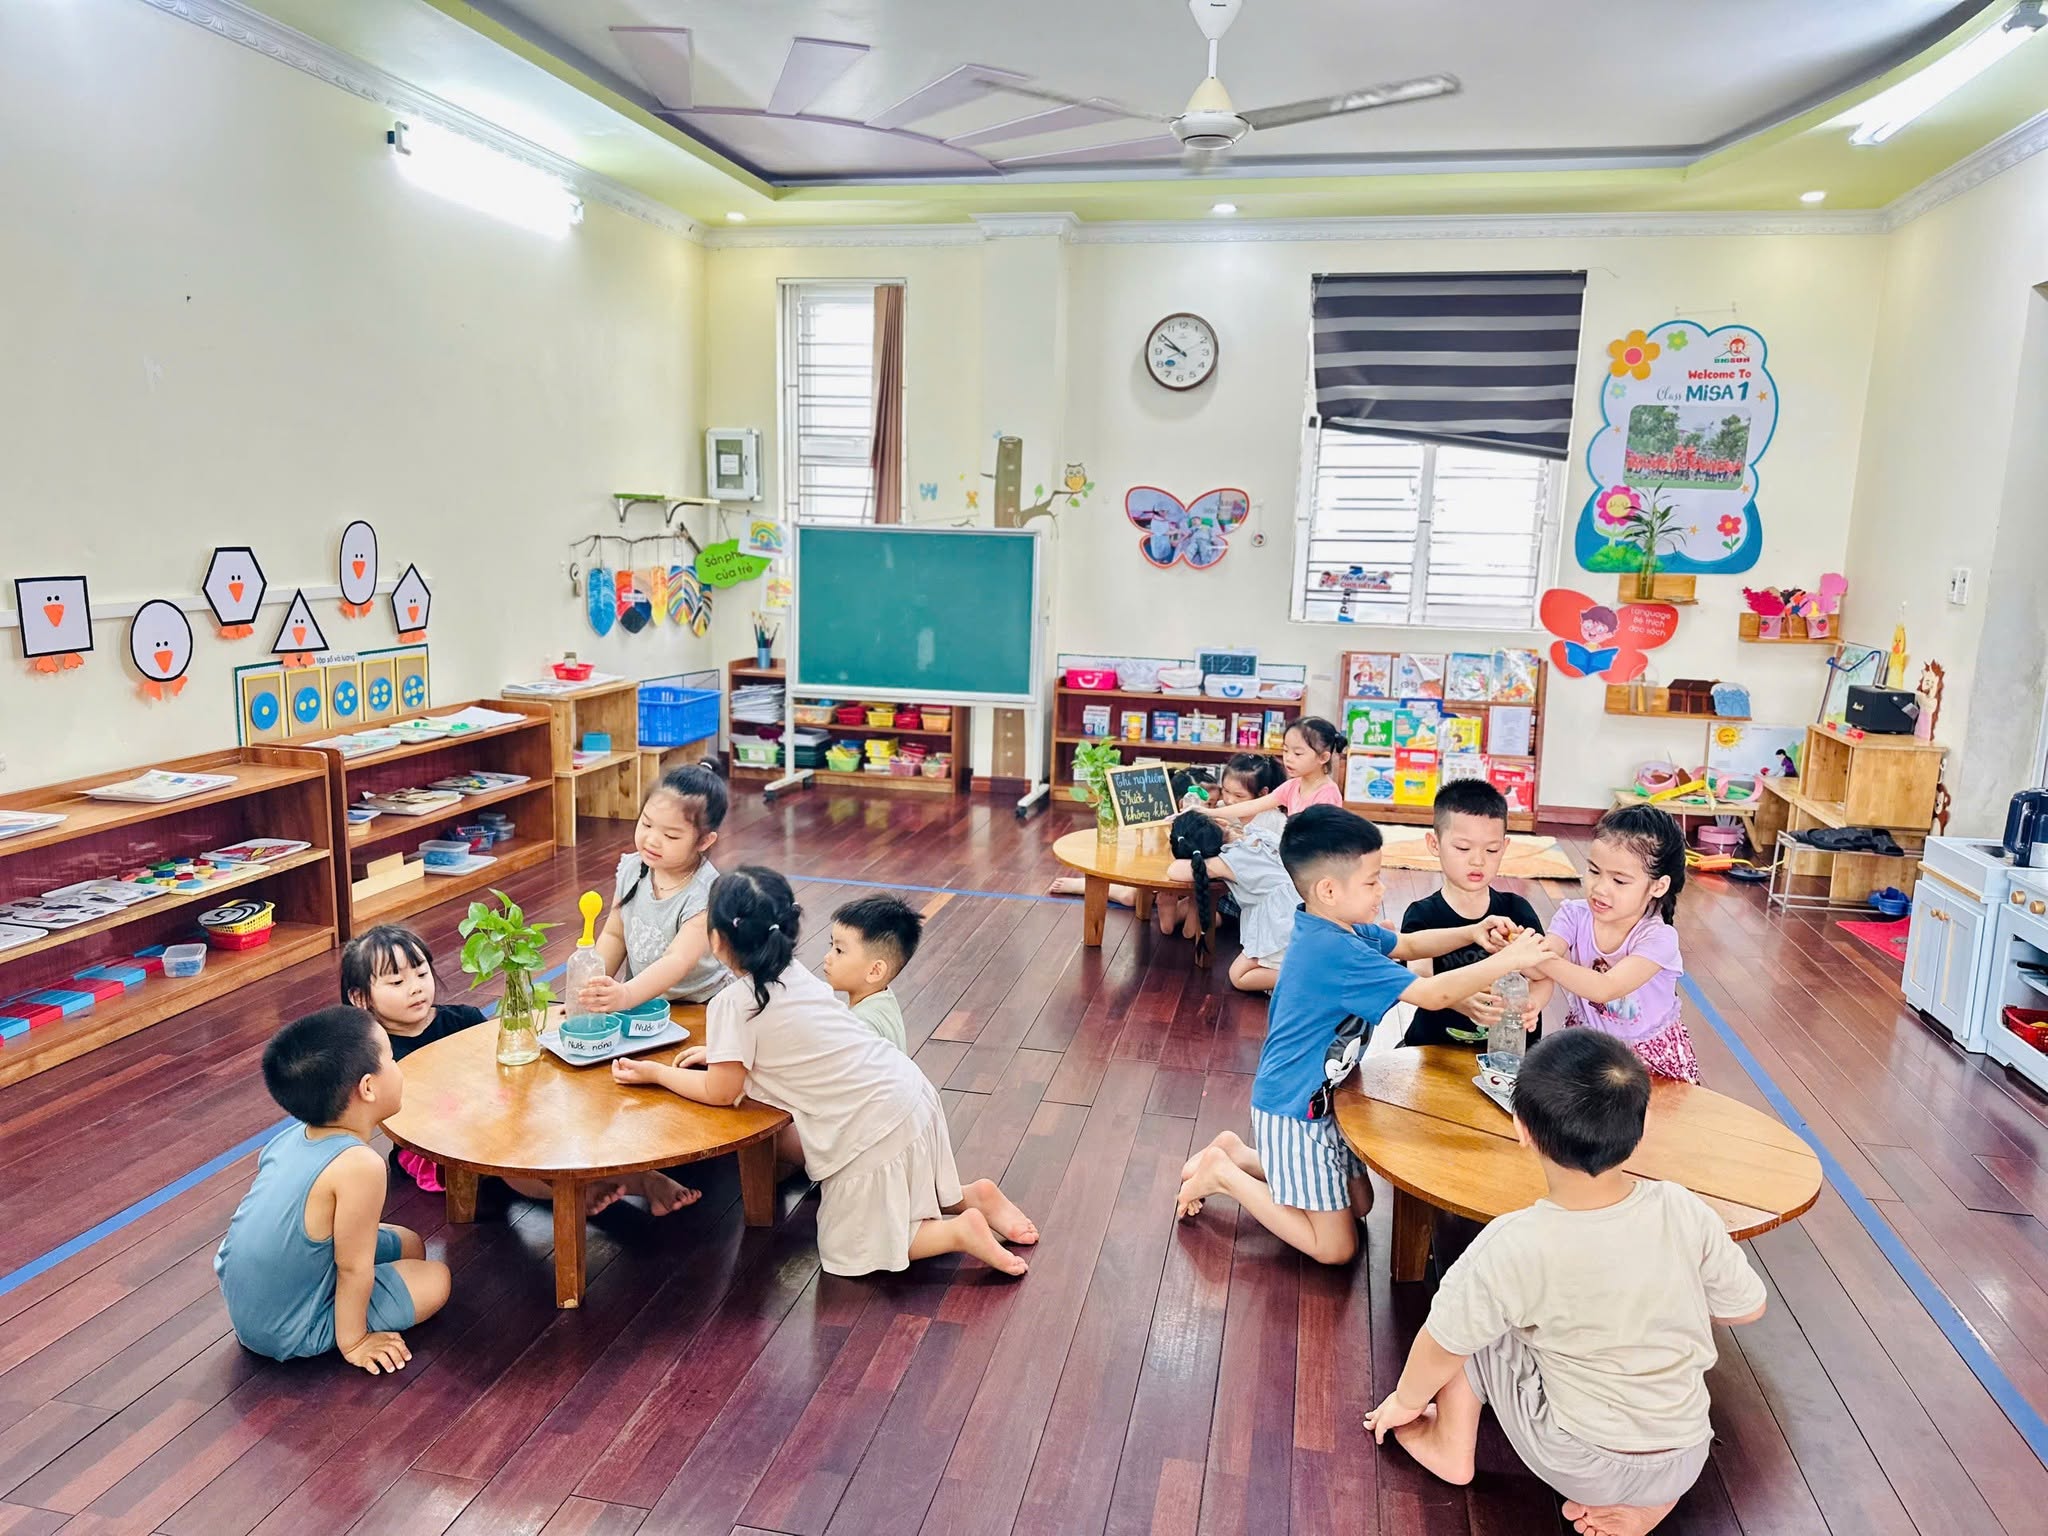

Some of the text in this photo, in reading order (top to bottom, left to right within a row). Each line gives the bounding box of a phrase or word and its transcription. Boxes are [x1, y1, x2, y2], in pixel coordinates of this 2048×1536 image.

[1200, 336, 1208, 344] 2
[1156, 360, 1164, 368] 8
[1688, 368, 1752, 380] Welcome To
[1656, 386, 1682, 402] Class
[1737, 381, 1749, 402] 1
[715, 568, 737, 581] của
[1630, 608, 1671, 620] Language
[1206, 655, 1250, 674] 1 2 3
